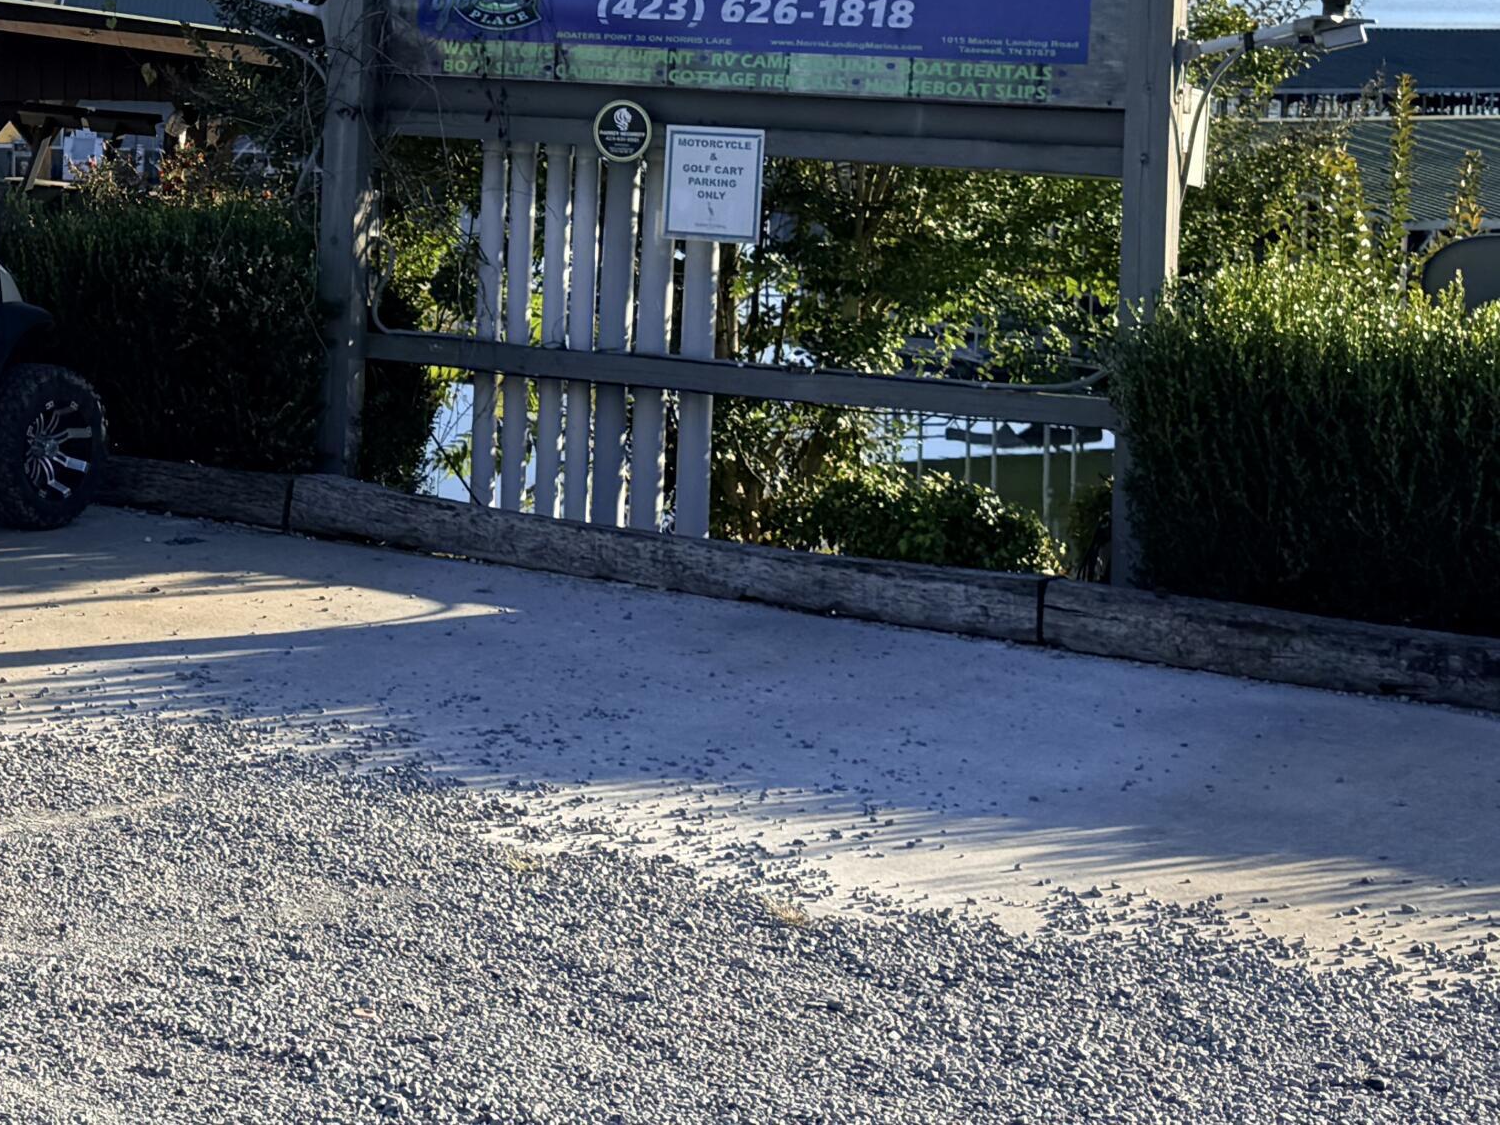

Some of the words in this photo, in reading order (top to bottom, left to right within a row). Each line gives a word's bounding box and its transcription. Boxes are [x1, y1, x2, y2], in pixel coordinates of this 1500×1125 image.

[468, 8, 529, 26] PLACE
[665, 36, 704, 45] NORRIS
[705, 37, 733, 46] LAKE
[967, 37, 1003, 46] Marina
[1005, 38, 1049, 49] Landing
[711, 52, 739, 67] RV
[960, 62, 1053, 81] RENTALS
[668, 69, 757, 88] COTTAGE
[994, 82, 1049, 100] SLIPS
[677, 137, 752, 151] MOTORCYCLE
[709, 152, 718, 161] &
[682, 163, 711, 174] GOLF
[714, 165, 744, 176] CART
[687, 176, 737, 189] PARKING
[697, 190, 726, 201] ONLY
